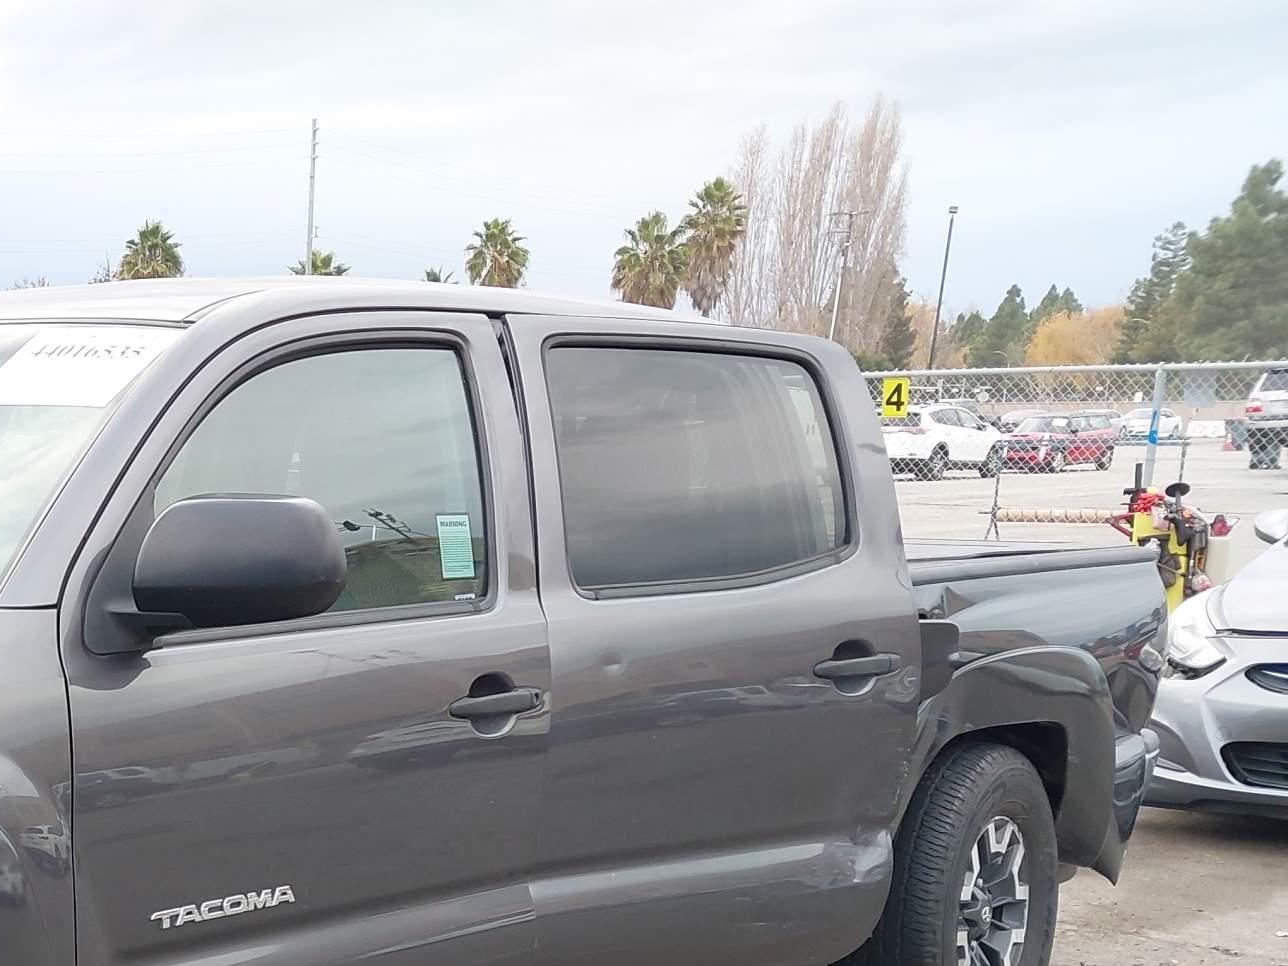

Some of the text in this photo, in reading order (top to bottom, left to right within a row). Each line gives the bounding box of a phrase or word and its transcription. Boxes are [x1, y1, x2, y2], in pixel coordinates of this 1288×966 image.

[885, 382, 905, 412] 4
[439, 520, 468, 528] WARNING
[149, 885, 296, 930] TACOMA
